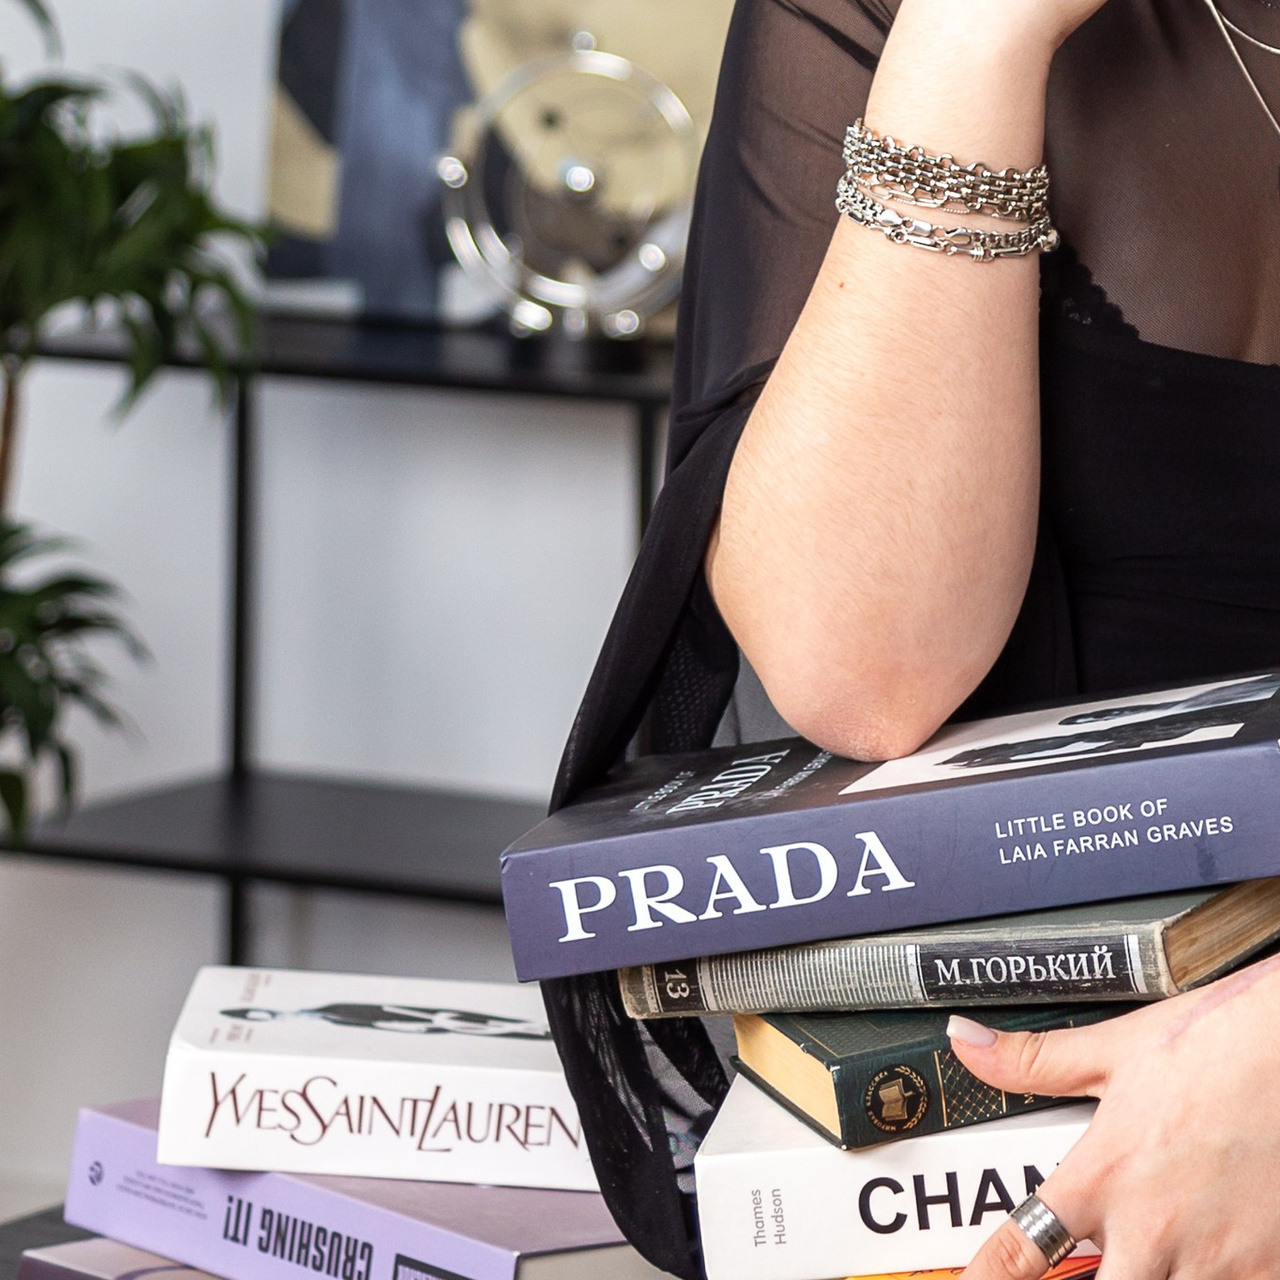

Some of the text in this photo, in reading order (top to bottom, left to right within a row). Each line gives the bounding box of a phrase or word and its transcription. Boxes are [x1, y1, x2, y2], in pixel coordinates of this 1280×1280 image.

[665, 749, 791, 815] PRADA
[995, 798, 1168, 838] LITTLE BOOK OF
[999, 816, 1234, 864] LAIA FARRAN GRAVES
[549, 831, 916, 943] PRADA
[664, 969, 690, 1000] 13
[934, 944, 1115, 986] М.ГОРЬКИЙ
[417, 1085, 580, 1153] LAUREN
[223, 1195, 253, 1247] IT!
[258, 1207, 374, 1280] CRUSHING
[751, 1188, 768, 1247] Thames
[773, 1188, 787, 1245] Hudson
